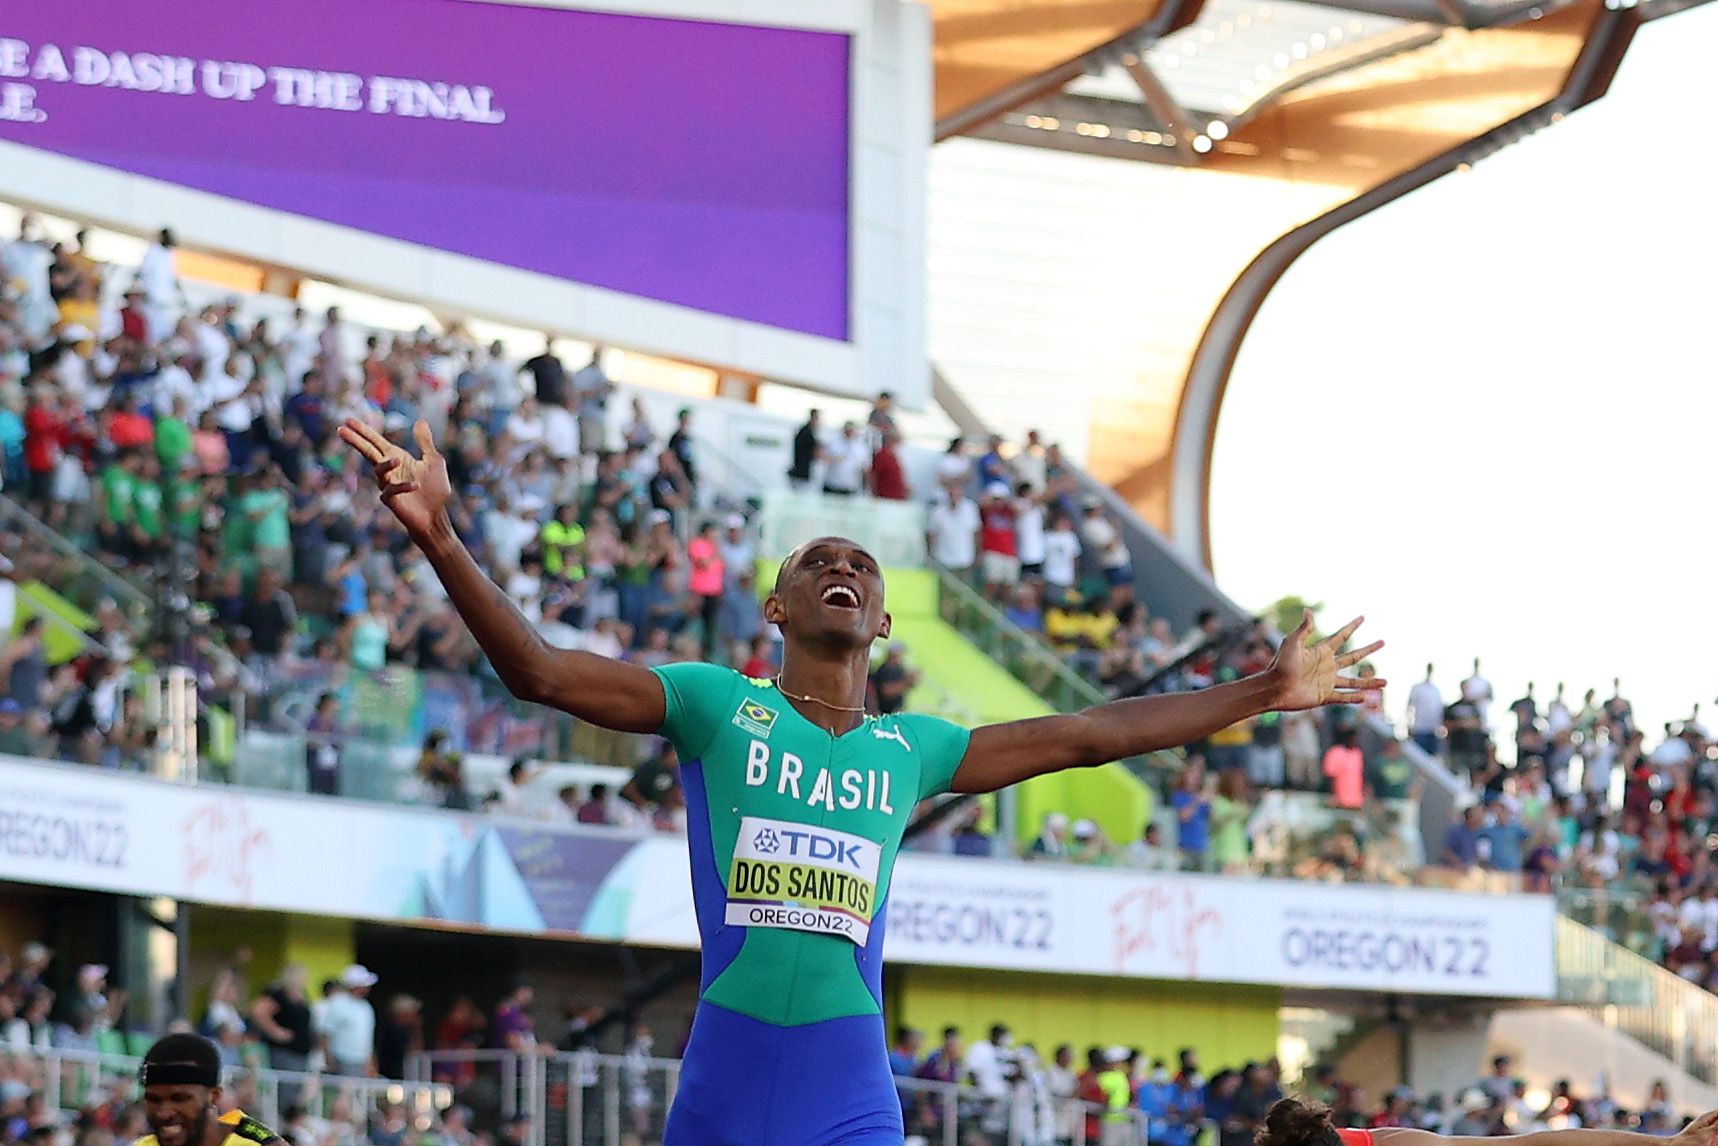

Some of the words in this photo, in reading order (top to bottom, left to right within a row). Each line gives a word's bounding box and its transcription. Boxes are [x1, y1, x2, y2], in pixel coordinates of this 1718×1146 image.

[30, 43, 72, 82] A
[71, 46, 197, 95] DASH
[201, 59, 266, 100] UP
[266, 65, 363, 111] THE
[367, 75, 505, 124] FINAL
[746, 739, 895, 815] BRASIL
[780, 830, 861, 869] TDK
[735, 861, 780, 895] DOS
[787, 865, 870, 914] SANTOS
[749, 907, 853, 934] OREGON22
